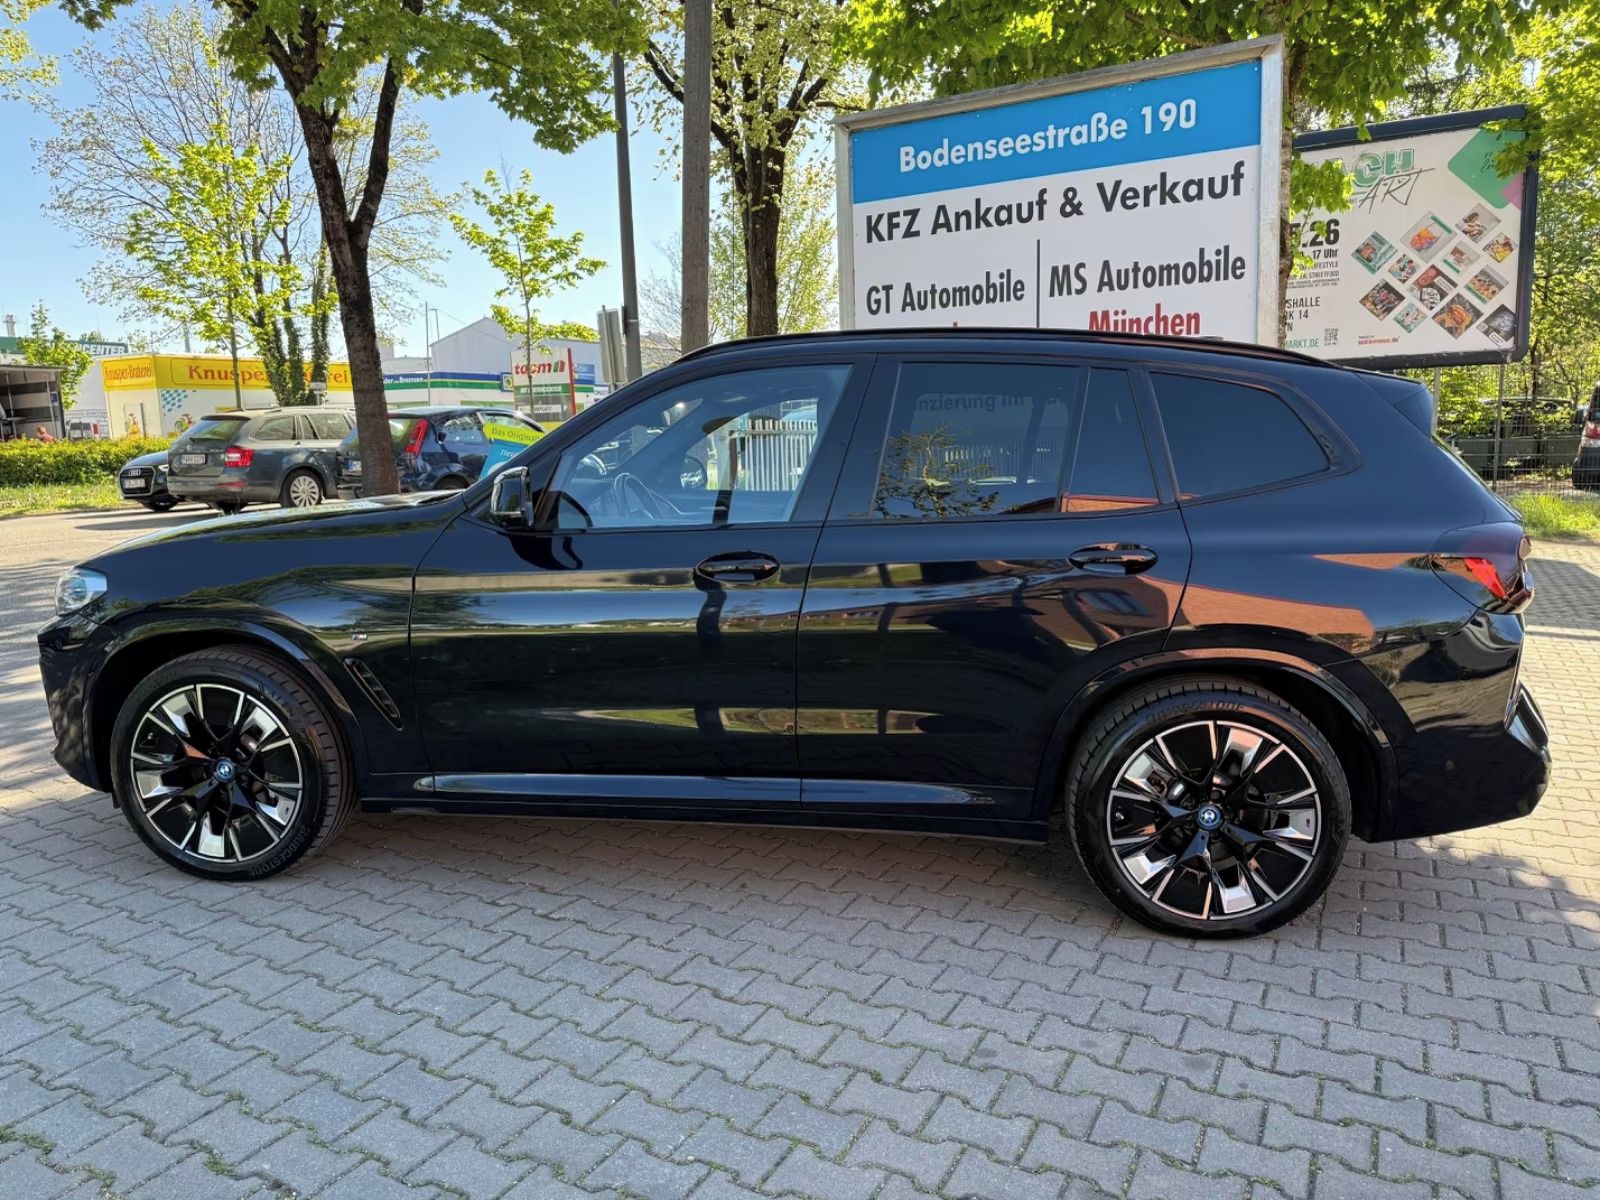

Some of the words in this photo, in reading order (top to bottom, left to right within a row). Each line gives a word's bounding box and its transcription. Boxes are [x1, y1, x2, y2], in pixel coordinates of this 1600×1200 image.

[899, 112, 1128, 174] Bodenseestraße
[1141, 97, 1197, 136] 190
[865, 208, 921, 244] KFZ
[931, 188, 1048, 236] Ankauf
[1059, 186, 1084, 219] &
[1096, 160, 1246, 213] Verkauf
[1323, 248, 1339, 259] Uhr
[1048, 262, 1087, 298] MS
[1097, 244, 1247, 294] Automobile
[866, 284, 893, 317] GT
[901, 268, 1026, 313] Automobile
[1286, 296, 1321, 309] SHALLE
[1088, 303, 1201, 337] München
[1299, 309, 1309, 320] 14
[78, 343, 125, 355] CENTER
[914, 393, 996, 412] nzierung
